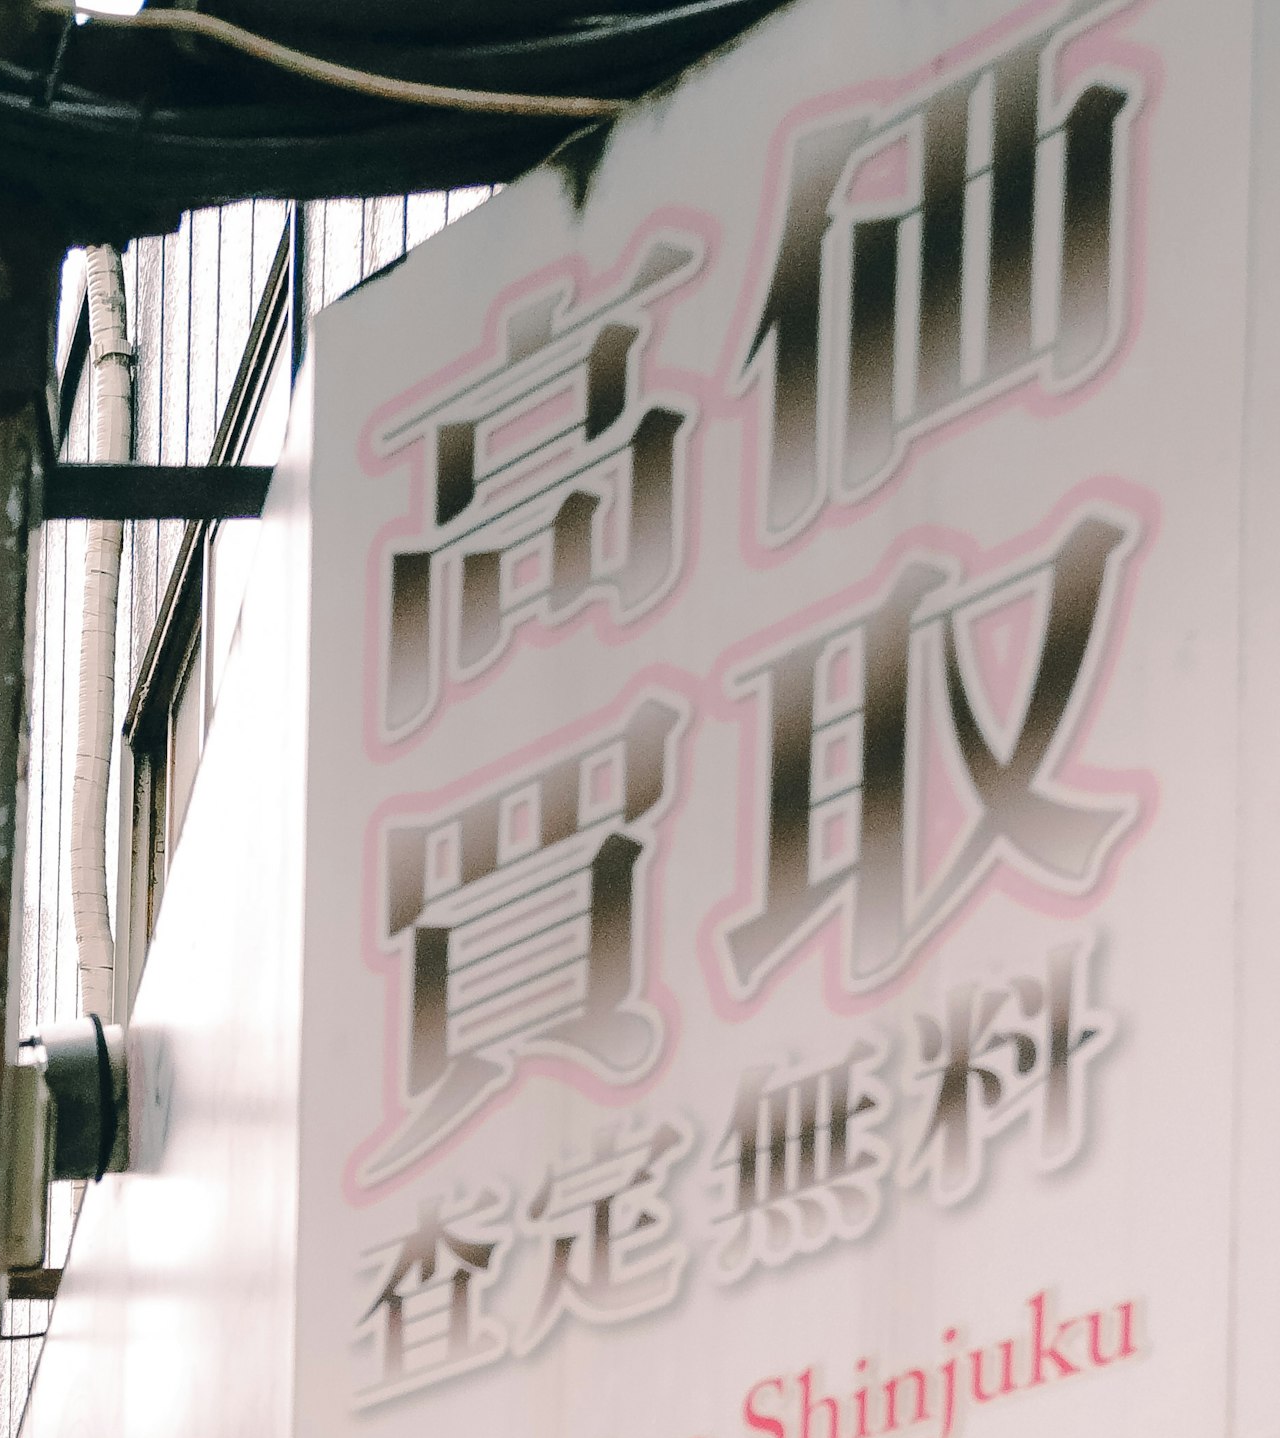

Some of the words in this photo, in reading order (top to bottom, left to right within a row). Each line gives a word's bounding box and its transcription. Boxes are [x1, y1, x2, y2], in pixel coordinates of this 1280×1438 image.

[376, 0, 1134, 742] 高価
[348, 925, 1118, 1414] 査定無料
[354, 515, 1142, 1186] 買取
